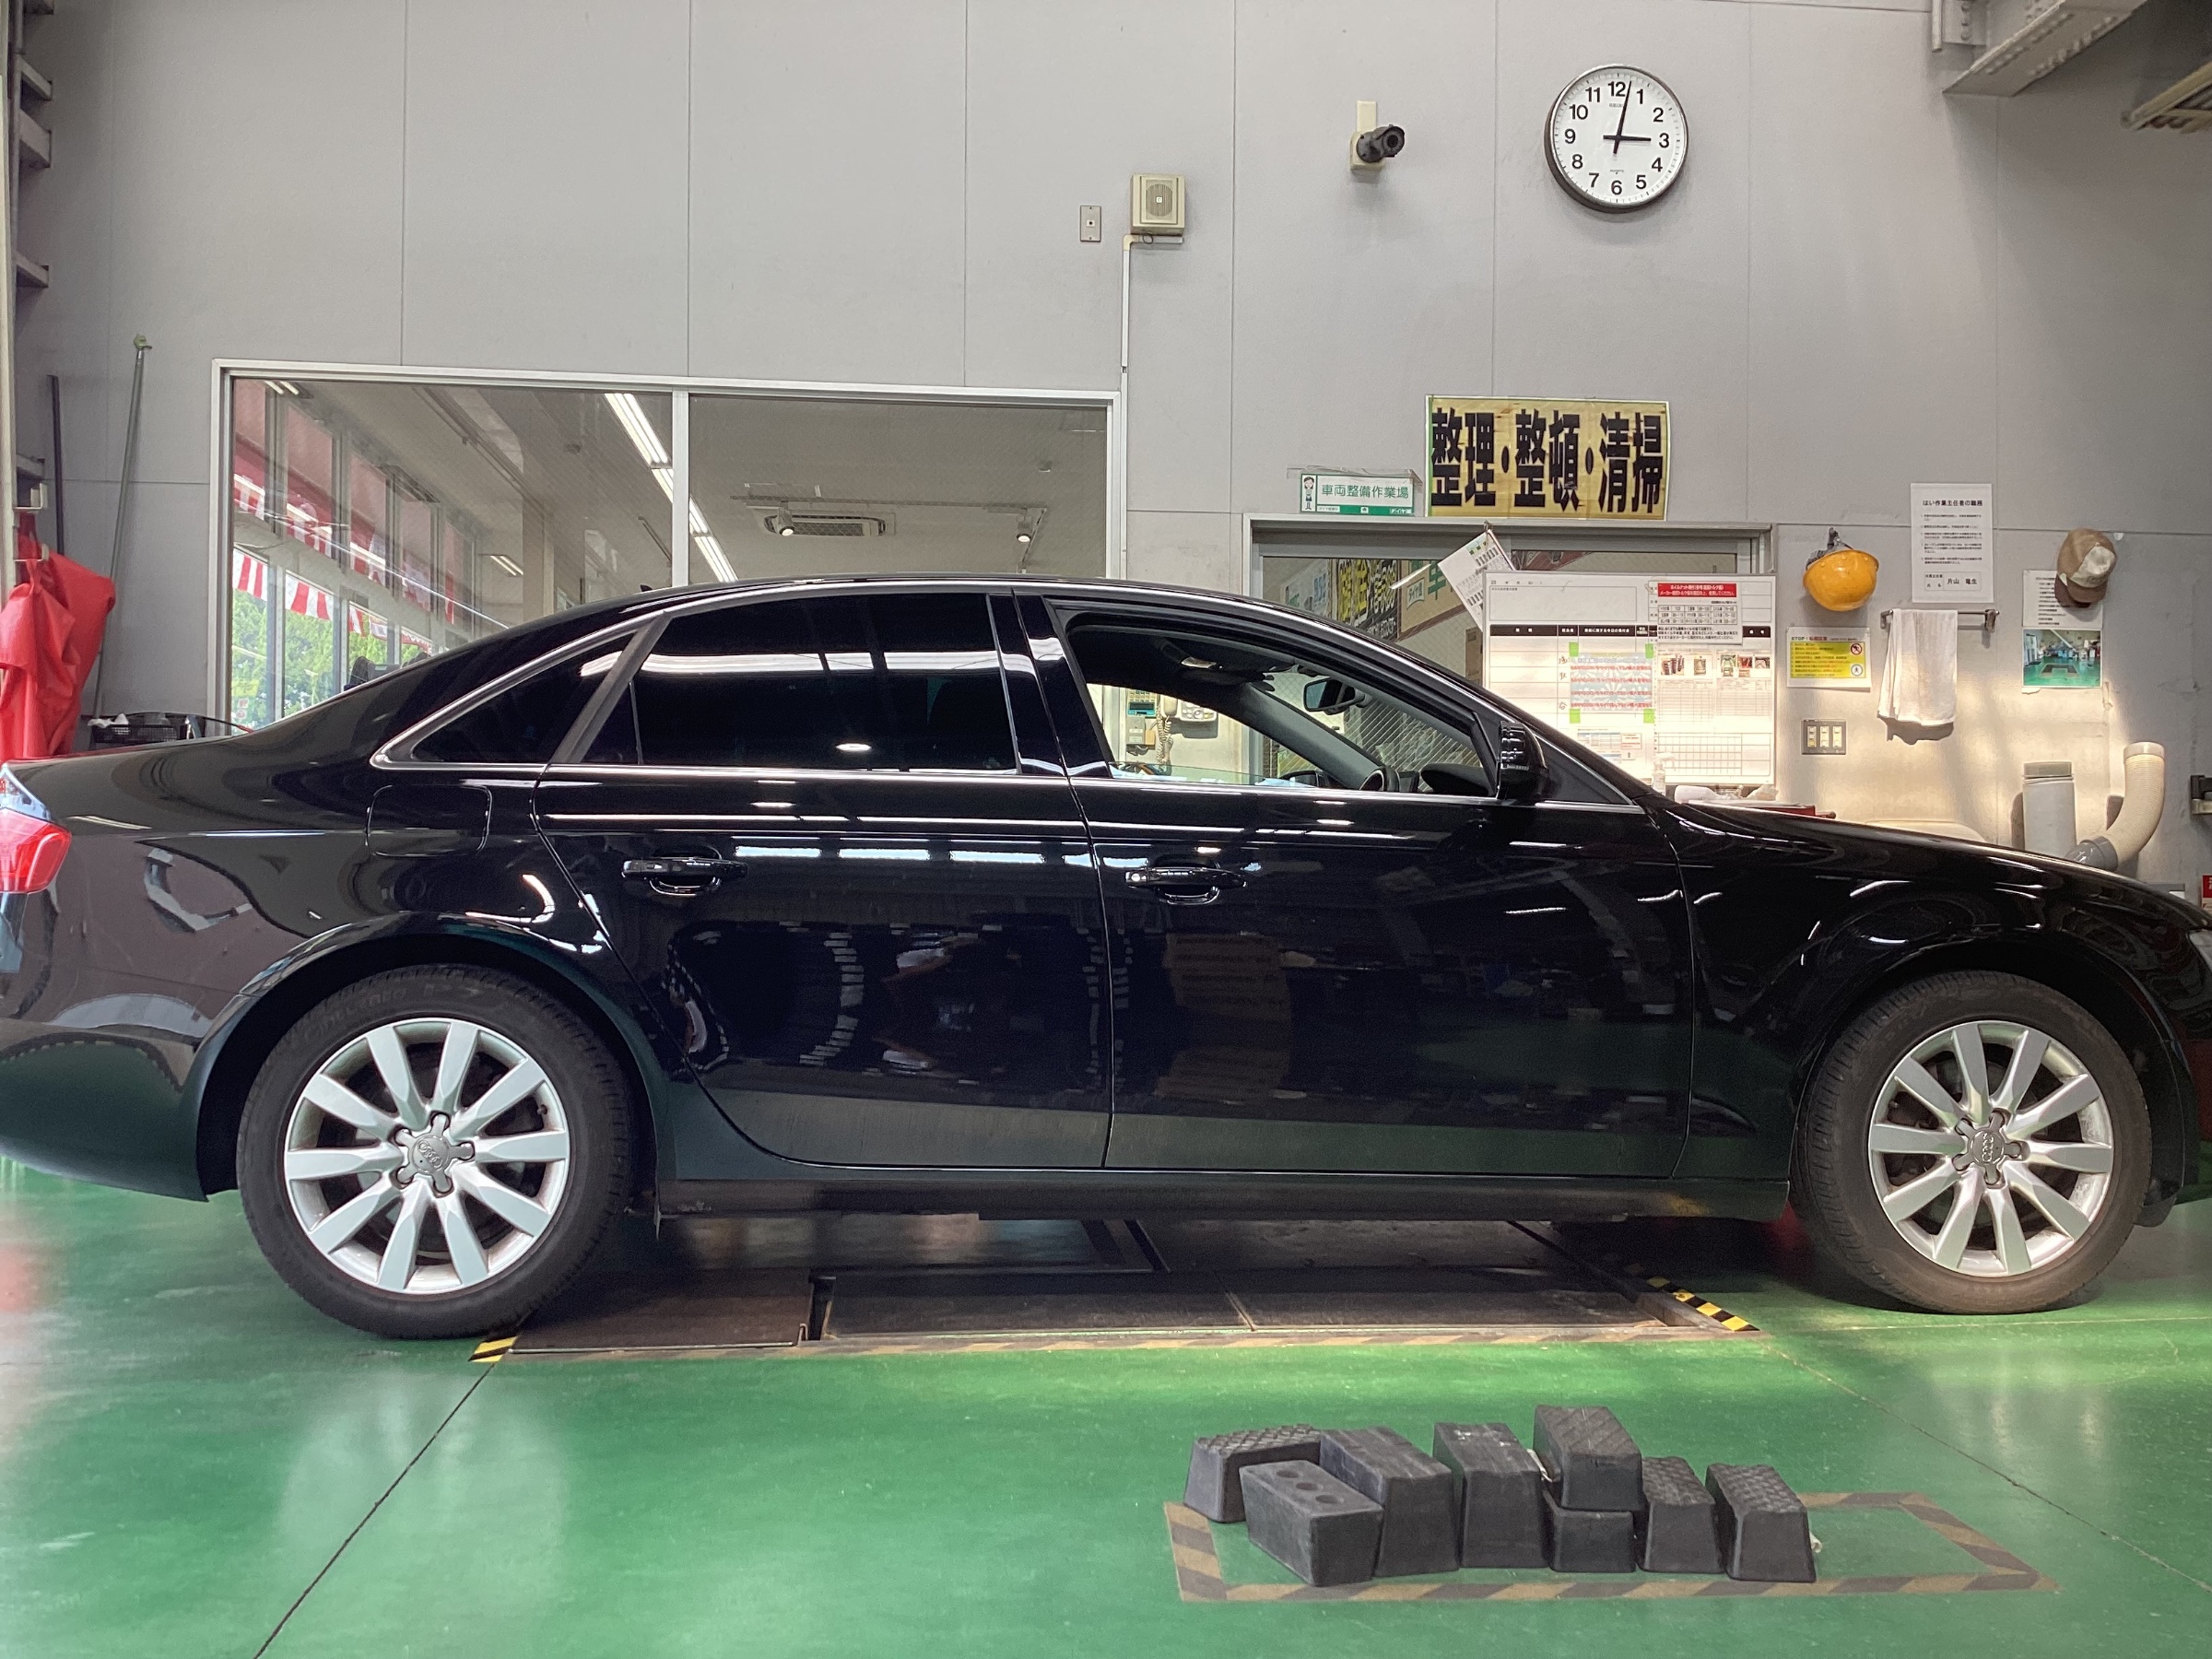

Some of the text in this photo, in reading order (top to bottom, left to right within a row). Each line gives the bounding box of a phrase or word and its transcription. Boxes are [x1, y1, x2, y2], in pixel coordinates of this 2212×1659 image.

[1585, 87, 1601, 102] 11
[1607, 81, 1626, 97] 12
[1636, 88, 1644, 104] 1
[1569, 104, 1589, 120] 10
[1653, 107, 1664, 123] 2
[1564, 128, 1576, 144] 9
[1659, 132, 1670, 148] 3
[1571, 153, 1583, 170] 8
[1651, 158, 1663, 172] 4
[1588, 172, 1600, 187] 7
[1610, 180, 1622, 195] 6
[1635, 174, 1647, 190] 5
[1430, 406, 1664, 513] 整理・整頓・清掃
[1321, 484, 1409, 500] 車両整備作業場
